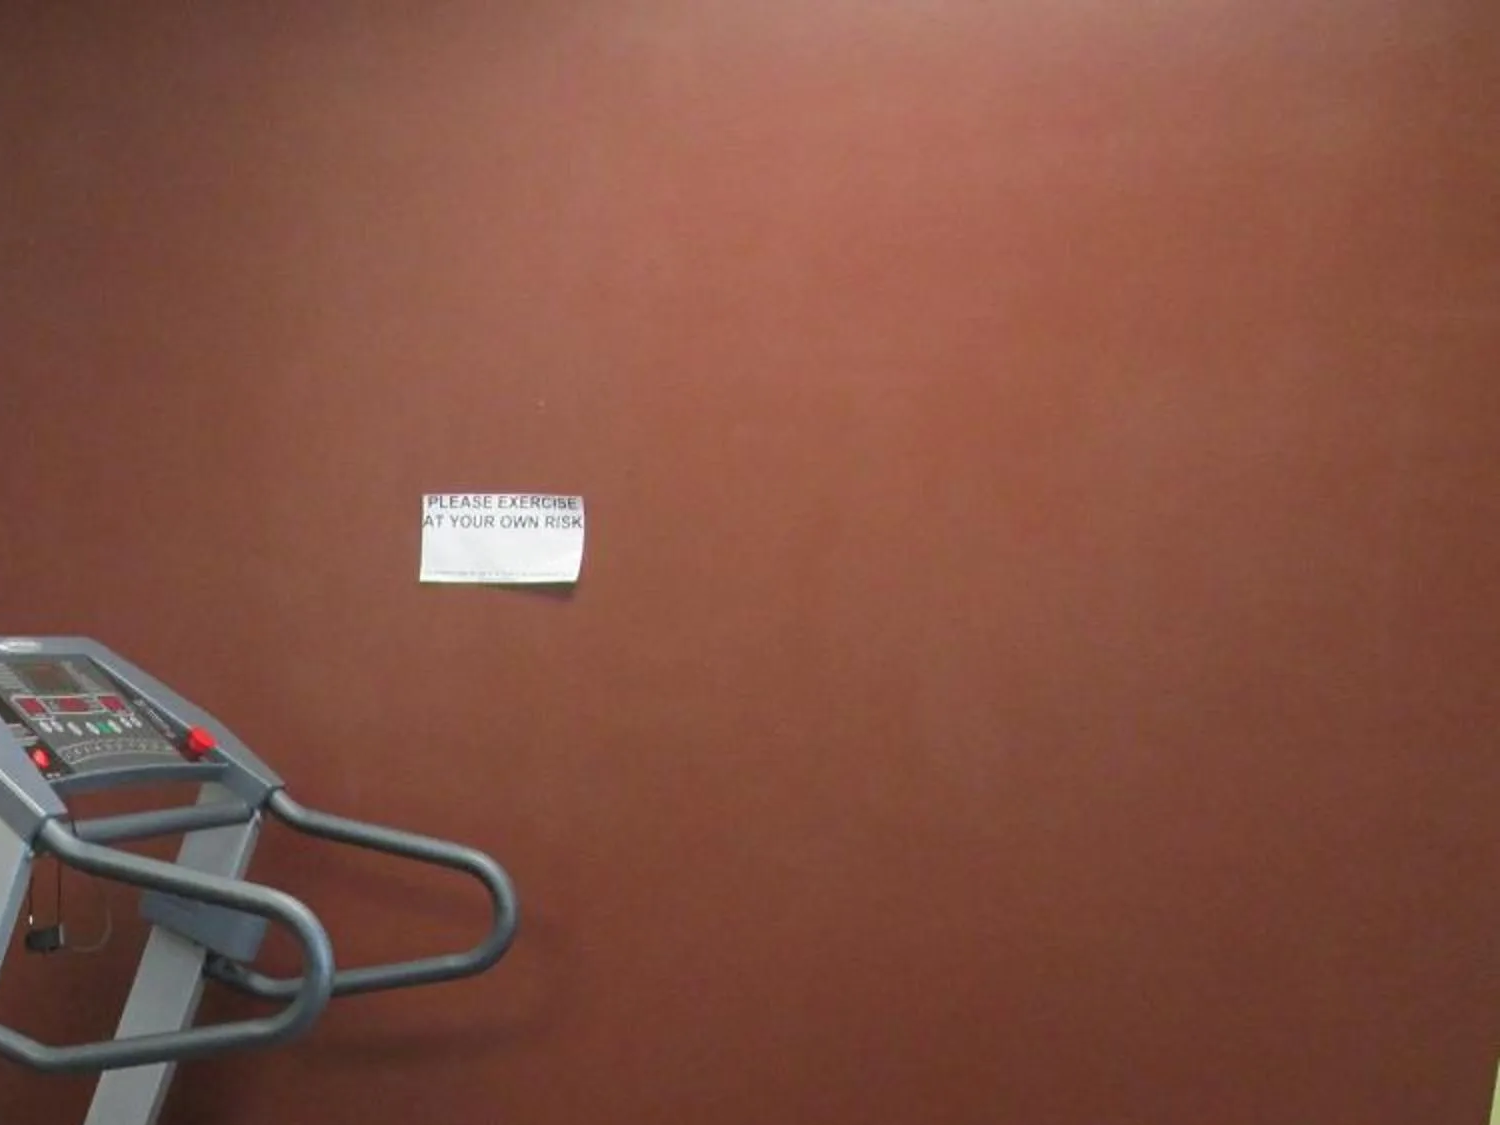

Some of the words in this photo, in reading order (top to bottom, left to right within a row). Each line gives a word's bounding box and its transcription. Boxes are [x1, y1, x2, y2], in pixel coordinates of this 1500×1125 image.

[428, 495, 493, 509] PLEASE
[498, 495, 577, 510] EXERCISE
[422, 516, 444, 528] AT
[450, 516, 495, 528] YOUR
[500, 516, 539, 529] OWN
[545, 516, 583, 529] RISK
